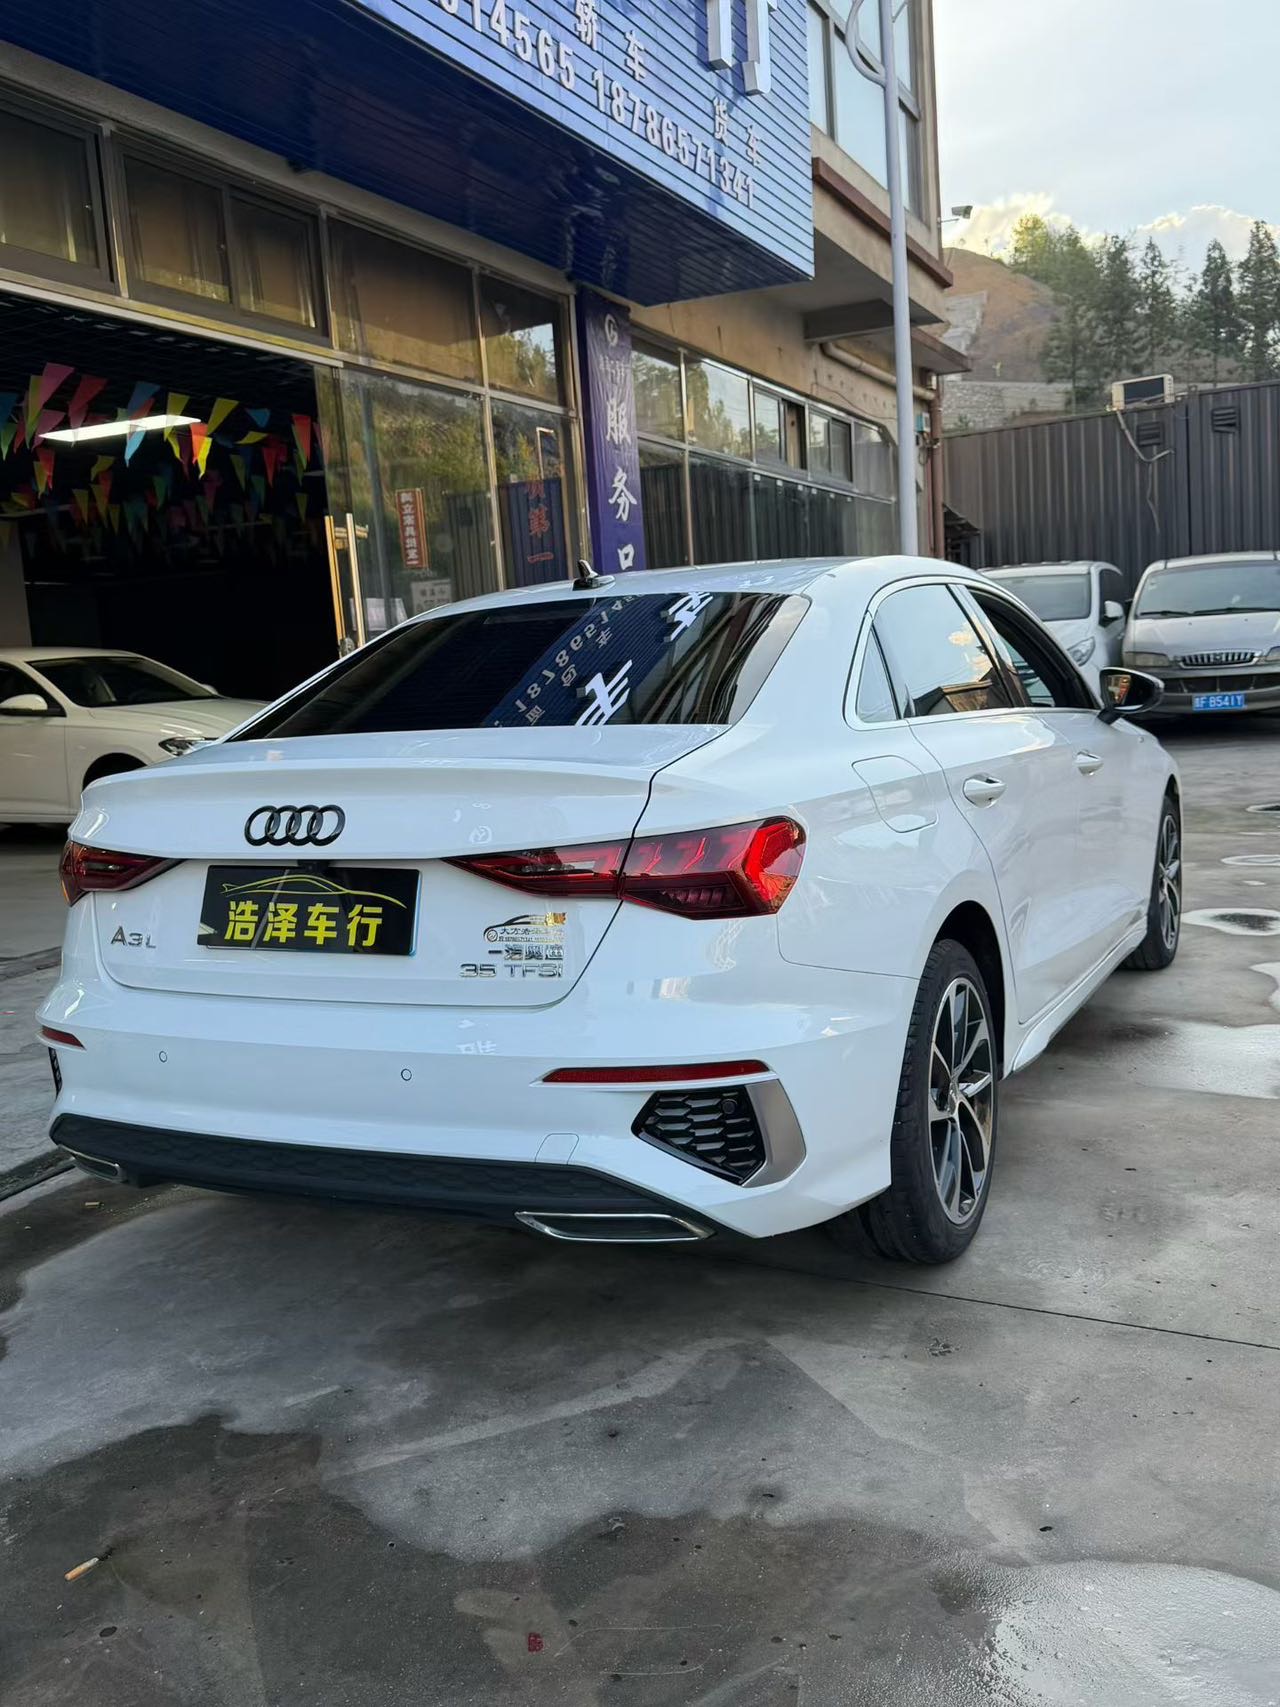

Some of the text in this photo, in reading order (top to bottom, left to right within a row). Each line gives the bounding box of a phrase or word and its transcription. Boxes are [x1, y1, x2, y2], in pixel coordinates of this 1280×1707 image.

[439, 0, 576, 90] 14565
[592, 68, 755, 210] 18786571341
[713, 96, 762, 167] 货车
[110, 925, 157, 949] A3L
[224, 900, 384, 947] 浩泽车行
[460, 963, 497, 978] 35
